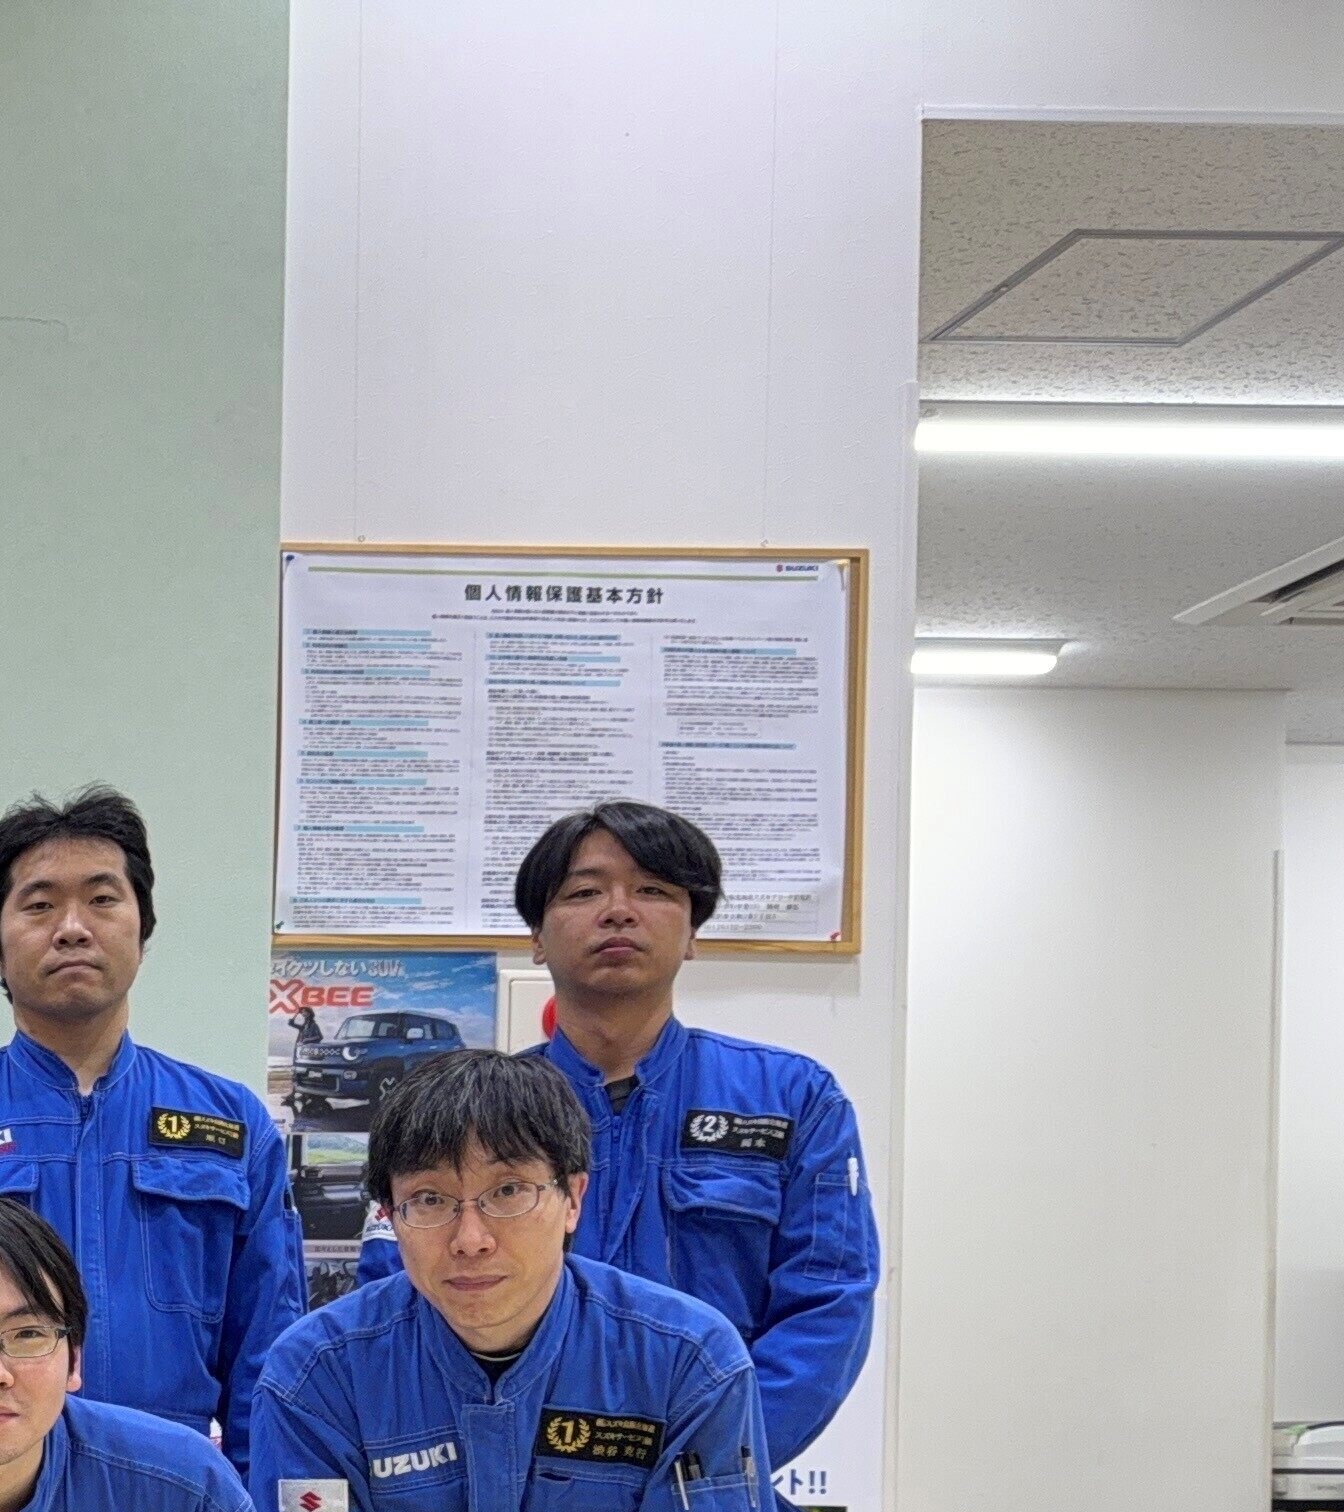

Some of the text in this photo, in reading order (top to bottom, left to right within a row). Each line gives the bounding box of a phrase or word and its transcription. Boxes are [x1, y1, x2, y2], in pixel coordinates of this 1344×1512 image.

[464, 584, 664, 604] 個人情報保護基本方針
[269, 979, 374, 1014] XBEE
[167, 1115, 177, 1133] 1
[703, 1115, 717, 1132] 2
[561, 1420, 575, 1443] 1
[370, 1441, 458, 1479] UZUKI
